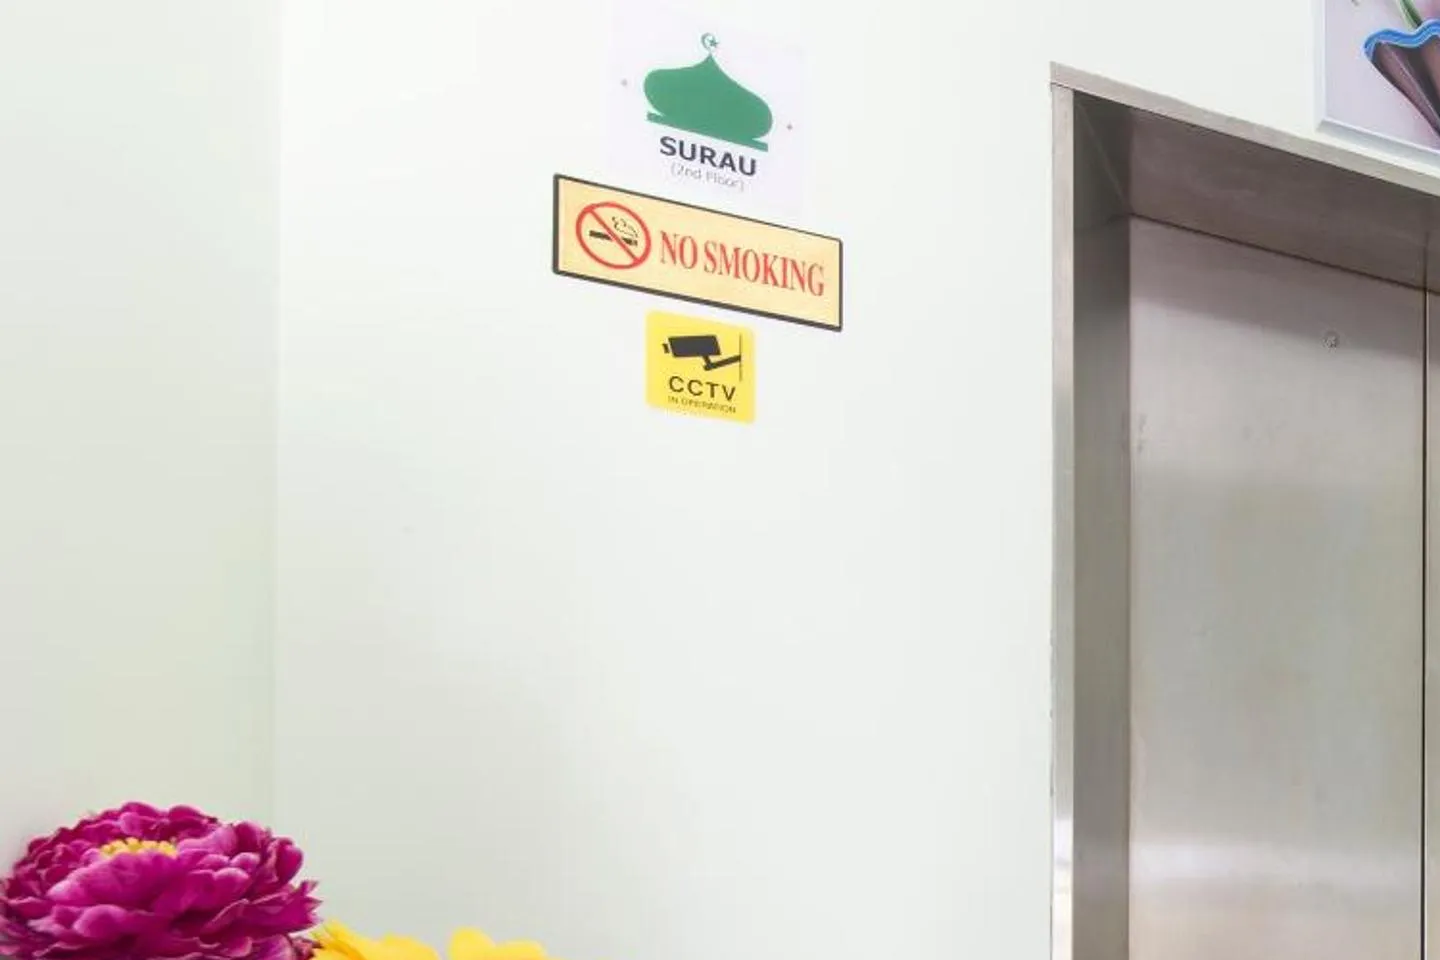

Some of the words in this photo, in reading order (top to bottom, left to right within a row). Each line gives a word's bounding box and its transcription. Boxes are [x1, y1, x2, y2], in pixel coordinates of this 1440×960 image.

[659, 135, 757, 177] SURAU
[670, 161, 702, 180] (2nd
[705, 170, 745, 193] Floor)
[659, 230, 699, 270] NO
[703, 239, 825, 297] SMOKING
[667, 395, 679, 404] IN
[681, 398, 737, 413] OPERATION
[668, 375, 737, 401] CCTV
